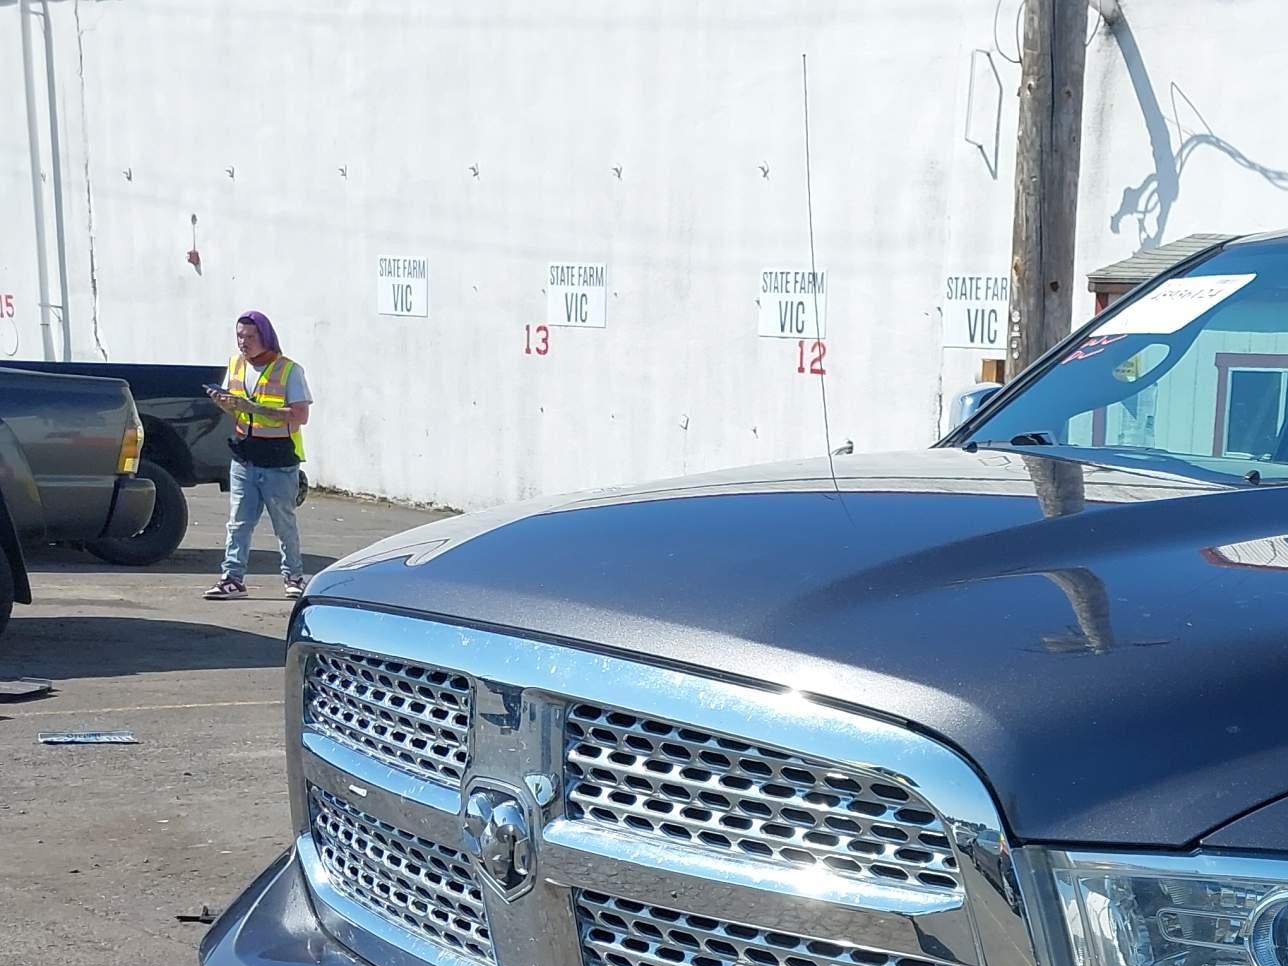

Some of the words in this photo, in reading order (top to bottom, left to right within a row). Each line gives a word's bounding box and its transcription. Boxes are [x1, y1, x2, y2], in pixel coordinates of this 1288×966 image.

[379, 258, 401, 278] STATE
[402, 259, 426, 279] FARM
[549, 265, 575, 286] STATE
[578, 266, 604, 287] FARM
[761, 271, 791, 294] STATE
[794, 272, 825, 295] FARM
[392, 283, 412, 313] VIC
[946, 276, 983, 301] STATE
[985, 277, 1008, 302] FAR
[564, 292, 588, 323] VIC
[778, 300, 805, 334] VIC
[524, 324, 549, 355] 13
[967, 308, 998, 344] VIC
[797, 340, 826, 375] 12
